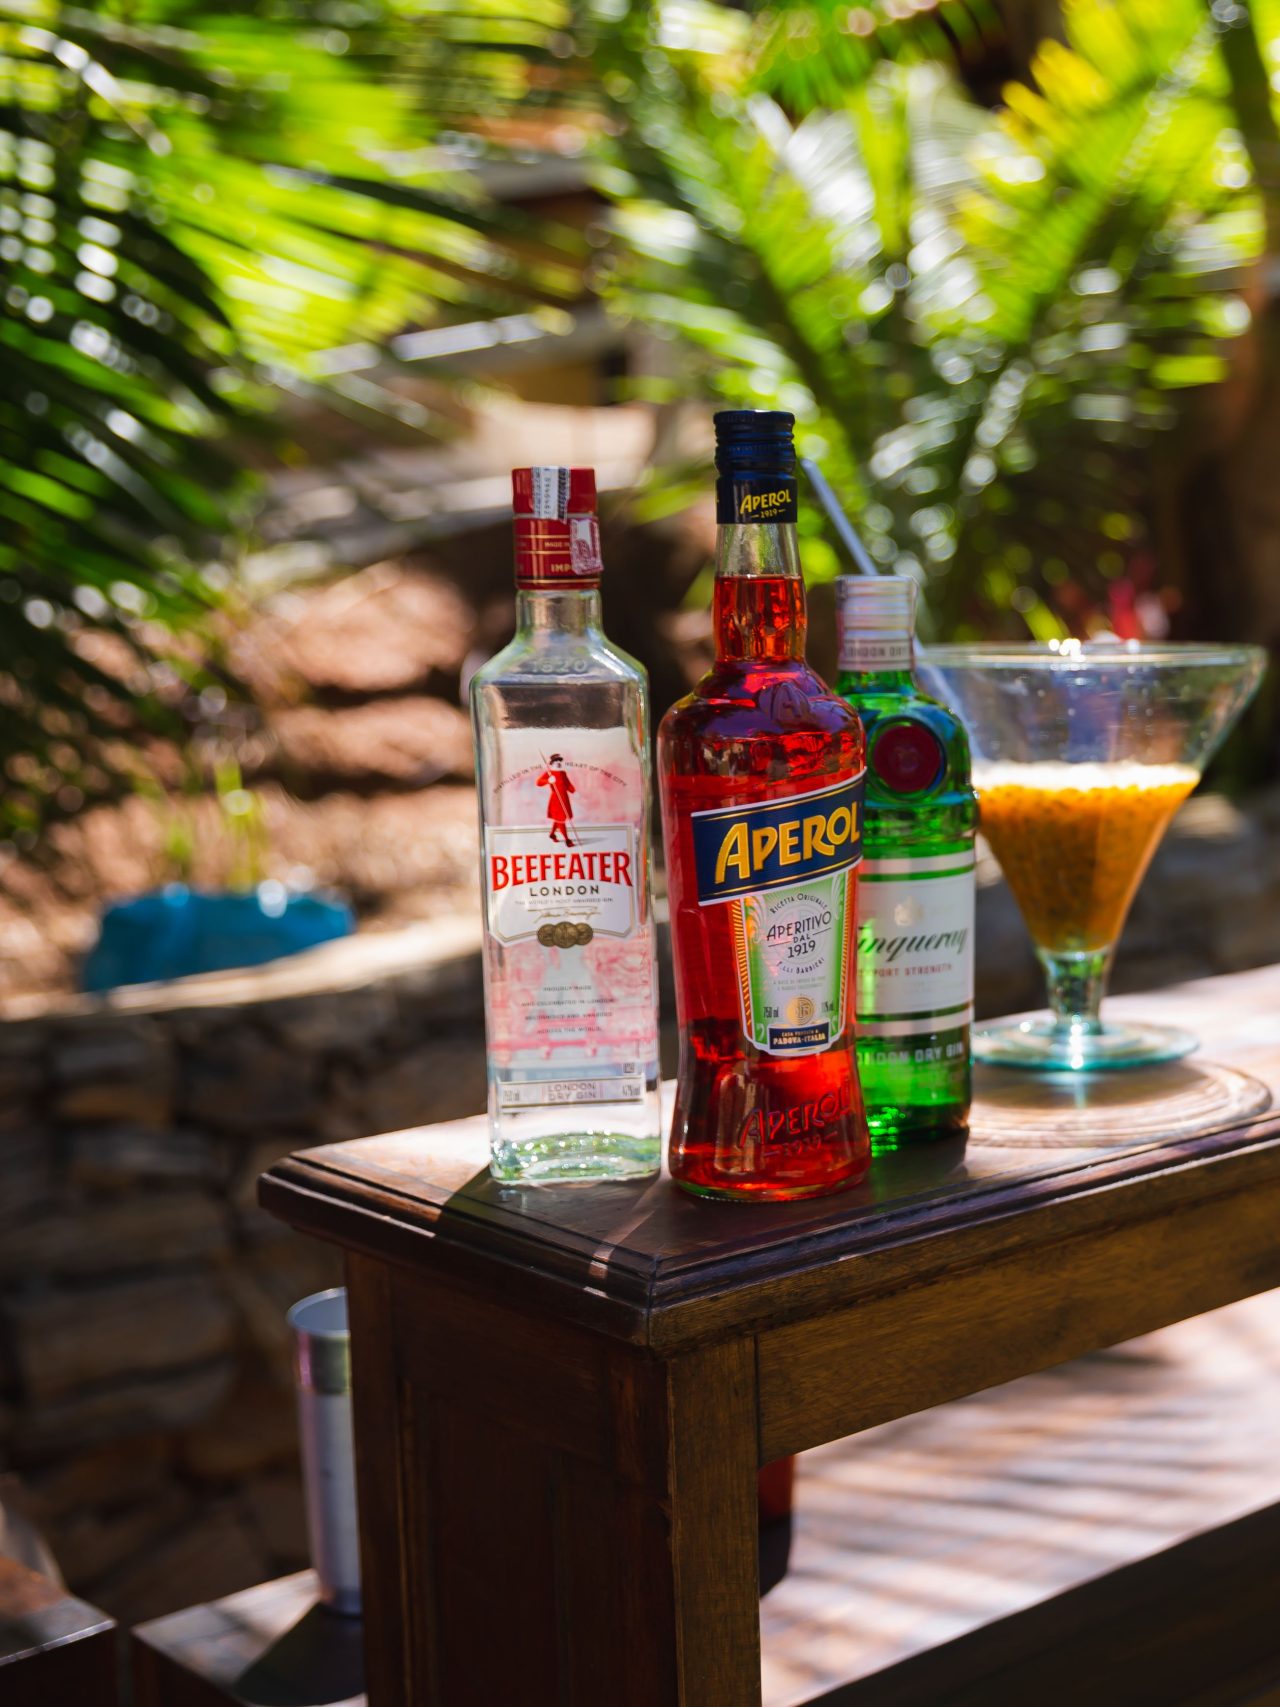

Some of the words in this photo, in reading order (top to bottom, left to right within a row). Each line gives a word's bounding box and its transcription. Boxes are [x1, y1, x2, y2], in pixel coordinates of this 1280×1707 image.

[740, 489, 791, 514] APEROL
[761, 508, 777, 518] 1919
[551, 563, 571, 573] IMP
[715, 801, 860, 884] APEROL
[491, 851, 633, 891] BEEFEATER
[530, 885, 600, 898] LONDON
[770, 896, 795, 914] RICETTA
[797, 893, 828, 909] ORIGINALE
[766, 911, 832, 941] APERITIVO
[793, 934, 811, 943] DAL
[787, 940, 816, 958] 1919
[915, 1046, 942, 1063] DRY
[548, 1082, 596, 1092] LONDON
[548, 1091, 571, 1101] DRY
[577, 1090, 596, 1100] GIN
[735, 1087, 849, 1152] APEROL
